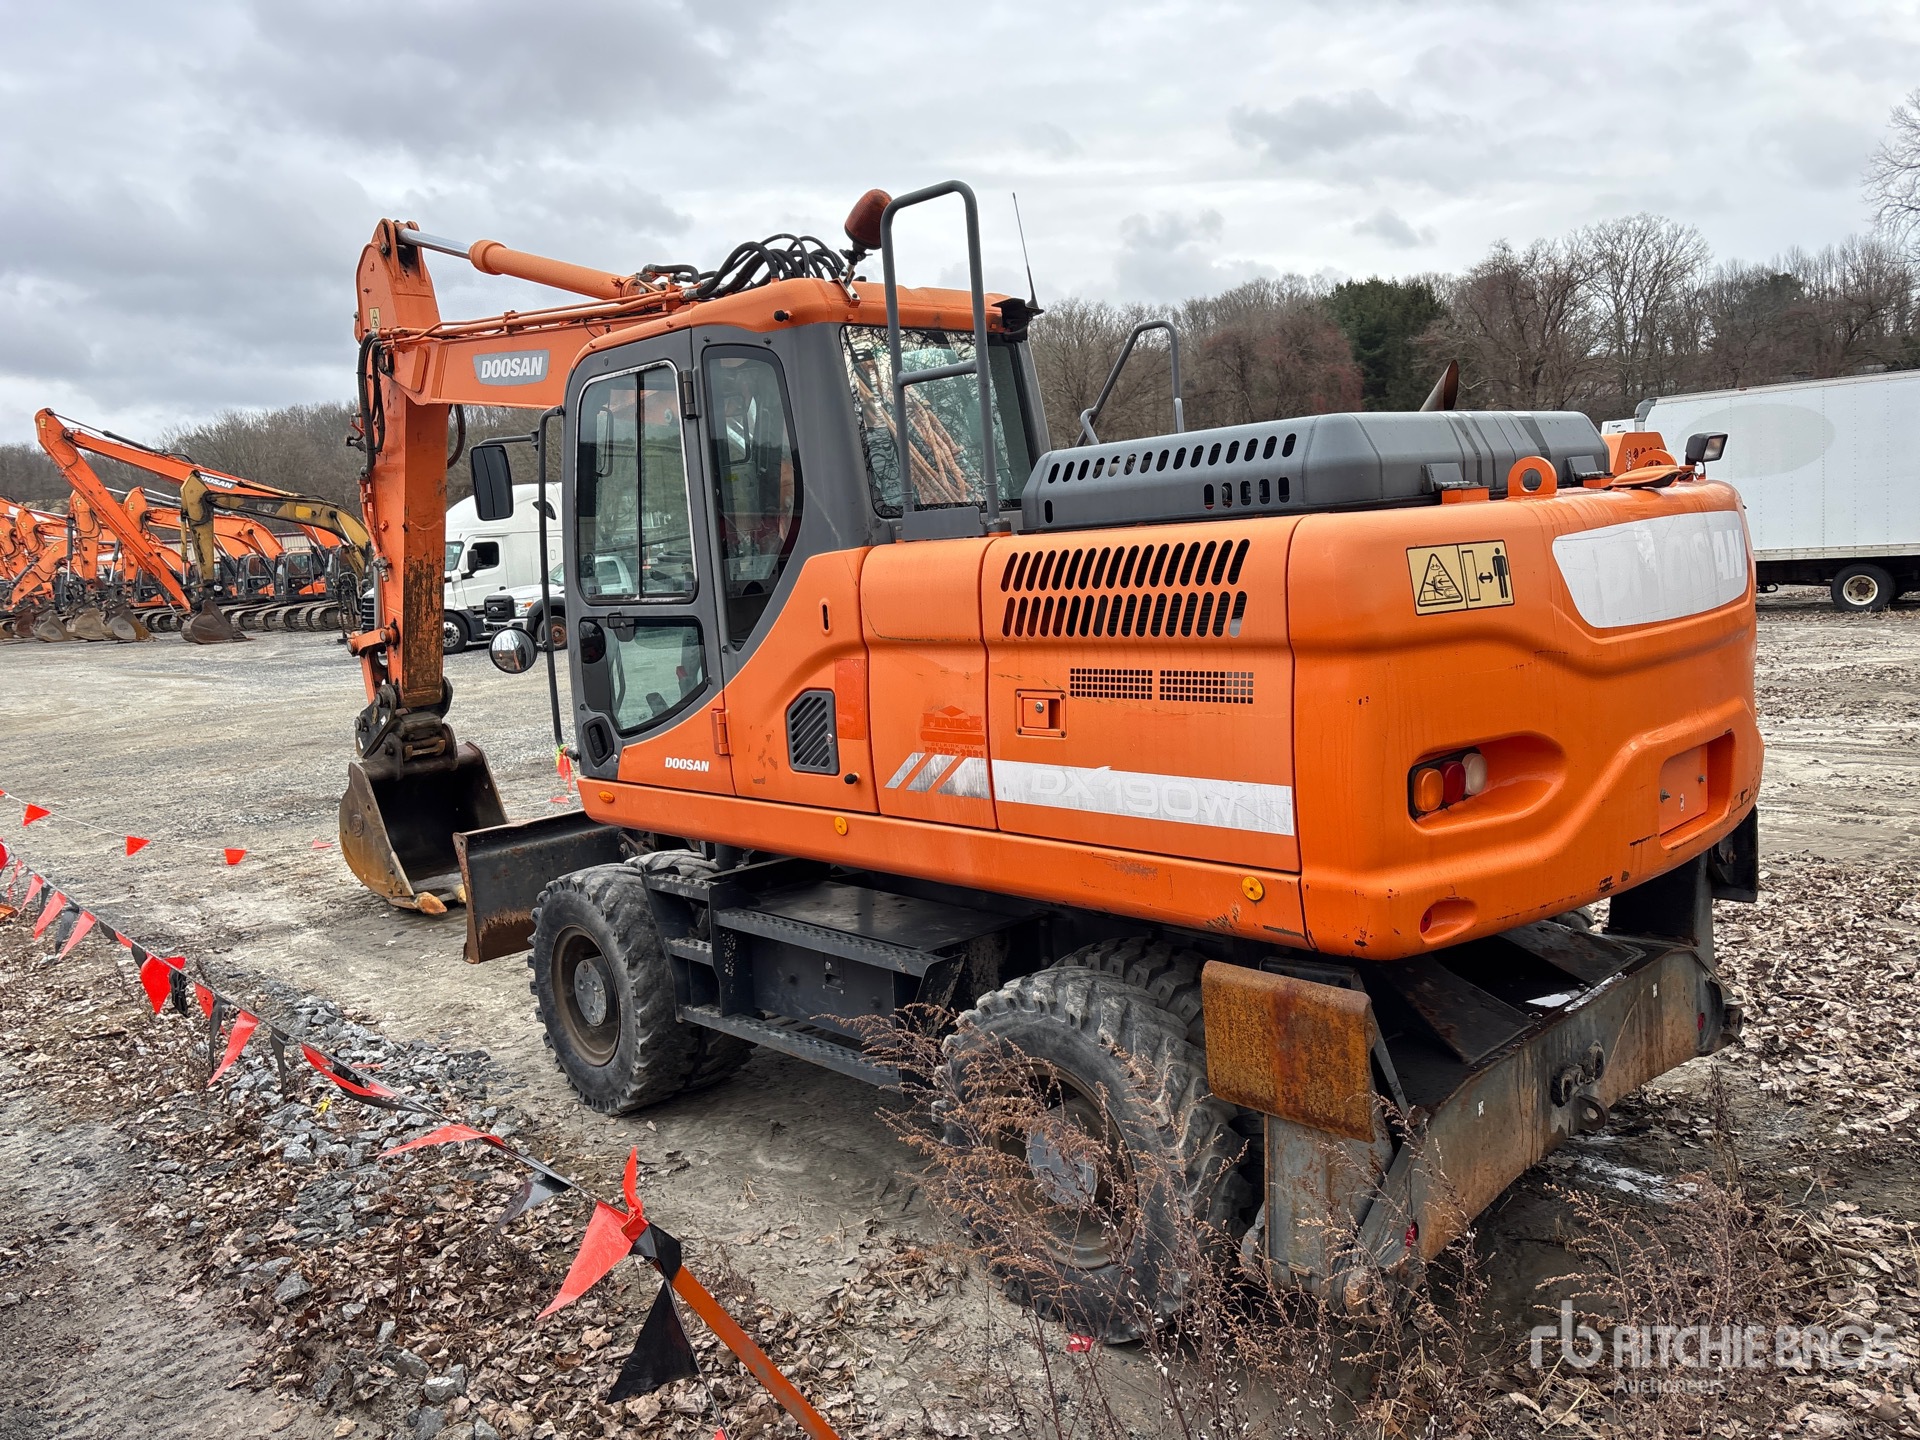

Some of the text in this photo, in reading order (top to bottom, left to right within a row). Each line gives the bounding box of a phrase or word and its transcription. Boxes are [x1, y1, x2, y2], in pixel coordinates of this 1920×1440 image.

[481, 356, 543, 379] DOOSAN
[200, 475, 233, 489] OOSAN
[922, 713, 982, 730] FINKE
[665, 756, 709, 773] DOOSAN
